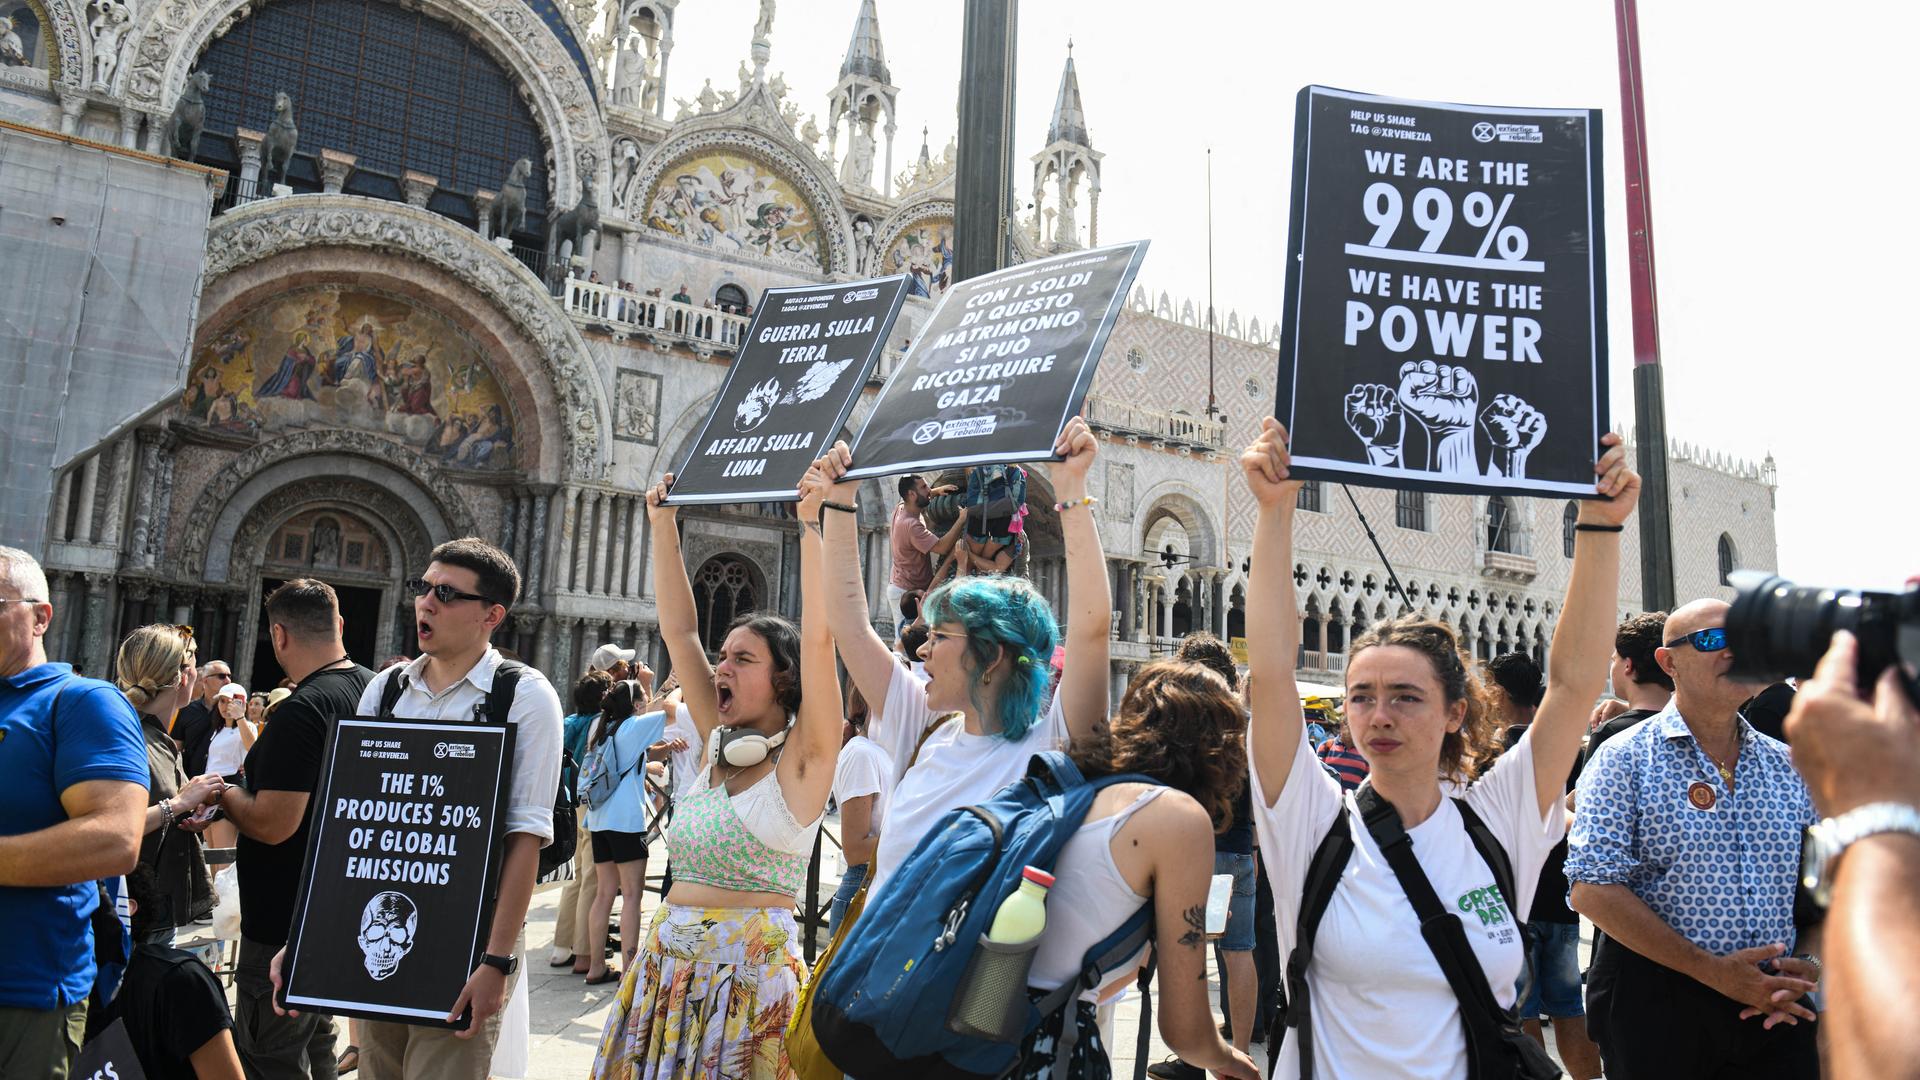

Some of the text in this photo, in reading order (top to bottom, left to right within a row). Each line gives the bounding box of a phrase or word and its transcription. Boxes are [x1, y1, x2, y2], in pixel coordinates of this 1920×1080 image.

[1350, 109, 1416, 127] HELP US SHARE
[1350, 123, 1432, 142] TAG @XRVENEZIA
[1364, 149, 1529, 187] WE ARE THE
[1362, 182, 1530, 263] 99%
[966, 271, 1093, 310] CON I SOLDI
[1348, 268, 1543, 311] WE HAVE THE
[960, 292, 1075, 327] DI QUESTO
[758, 315, 875, 345] GUERRA SULLA
[933, 309, 1082, 350] MATRIMONIO
[1344, 300, 1544, 364] POWER
[778, 343, 828, 365] TERRA
[956, 335, 1031, 364] SI PUÒ
[911, 354, 1057, 391] RICOSTRUIRE
[936, 384, 1002, 410] GAZA
[945, 418, 988, 430] extinction
[953, 425, 993, 437] rebellion
[705, 431, 813, 457] AFFARI SULLA
[722, 458, 768, 478] LUNA
[359, 750, 372, 758] TAG
[361, 739, 402, 749] HELP US SHARE
[380, 772, 445, 798] THE 1%
[334, 798, 482, 829] PRODUCES 50%
[348, 827, 458, 857] OF GLOBAL
[345, 856, 451, 886] EMISSIONS
[1458, 884, 1504, 913] GREE
